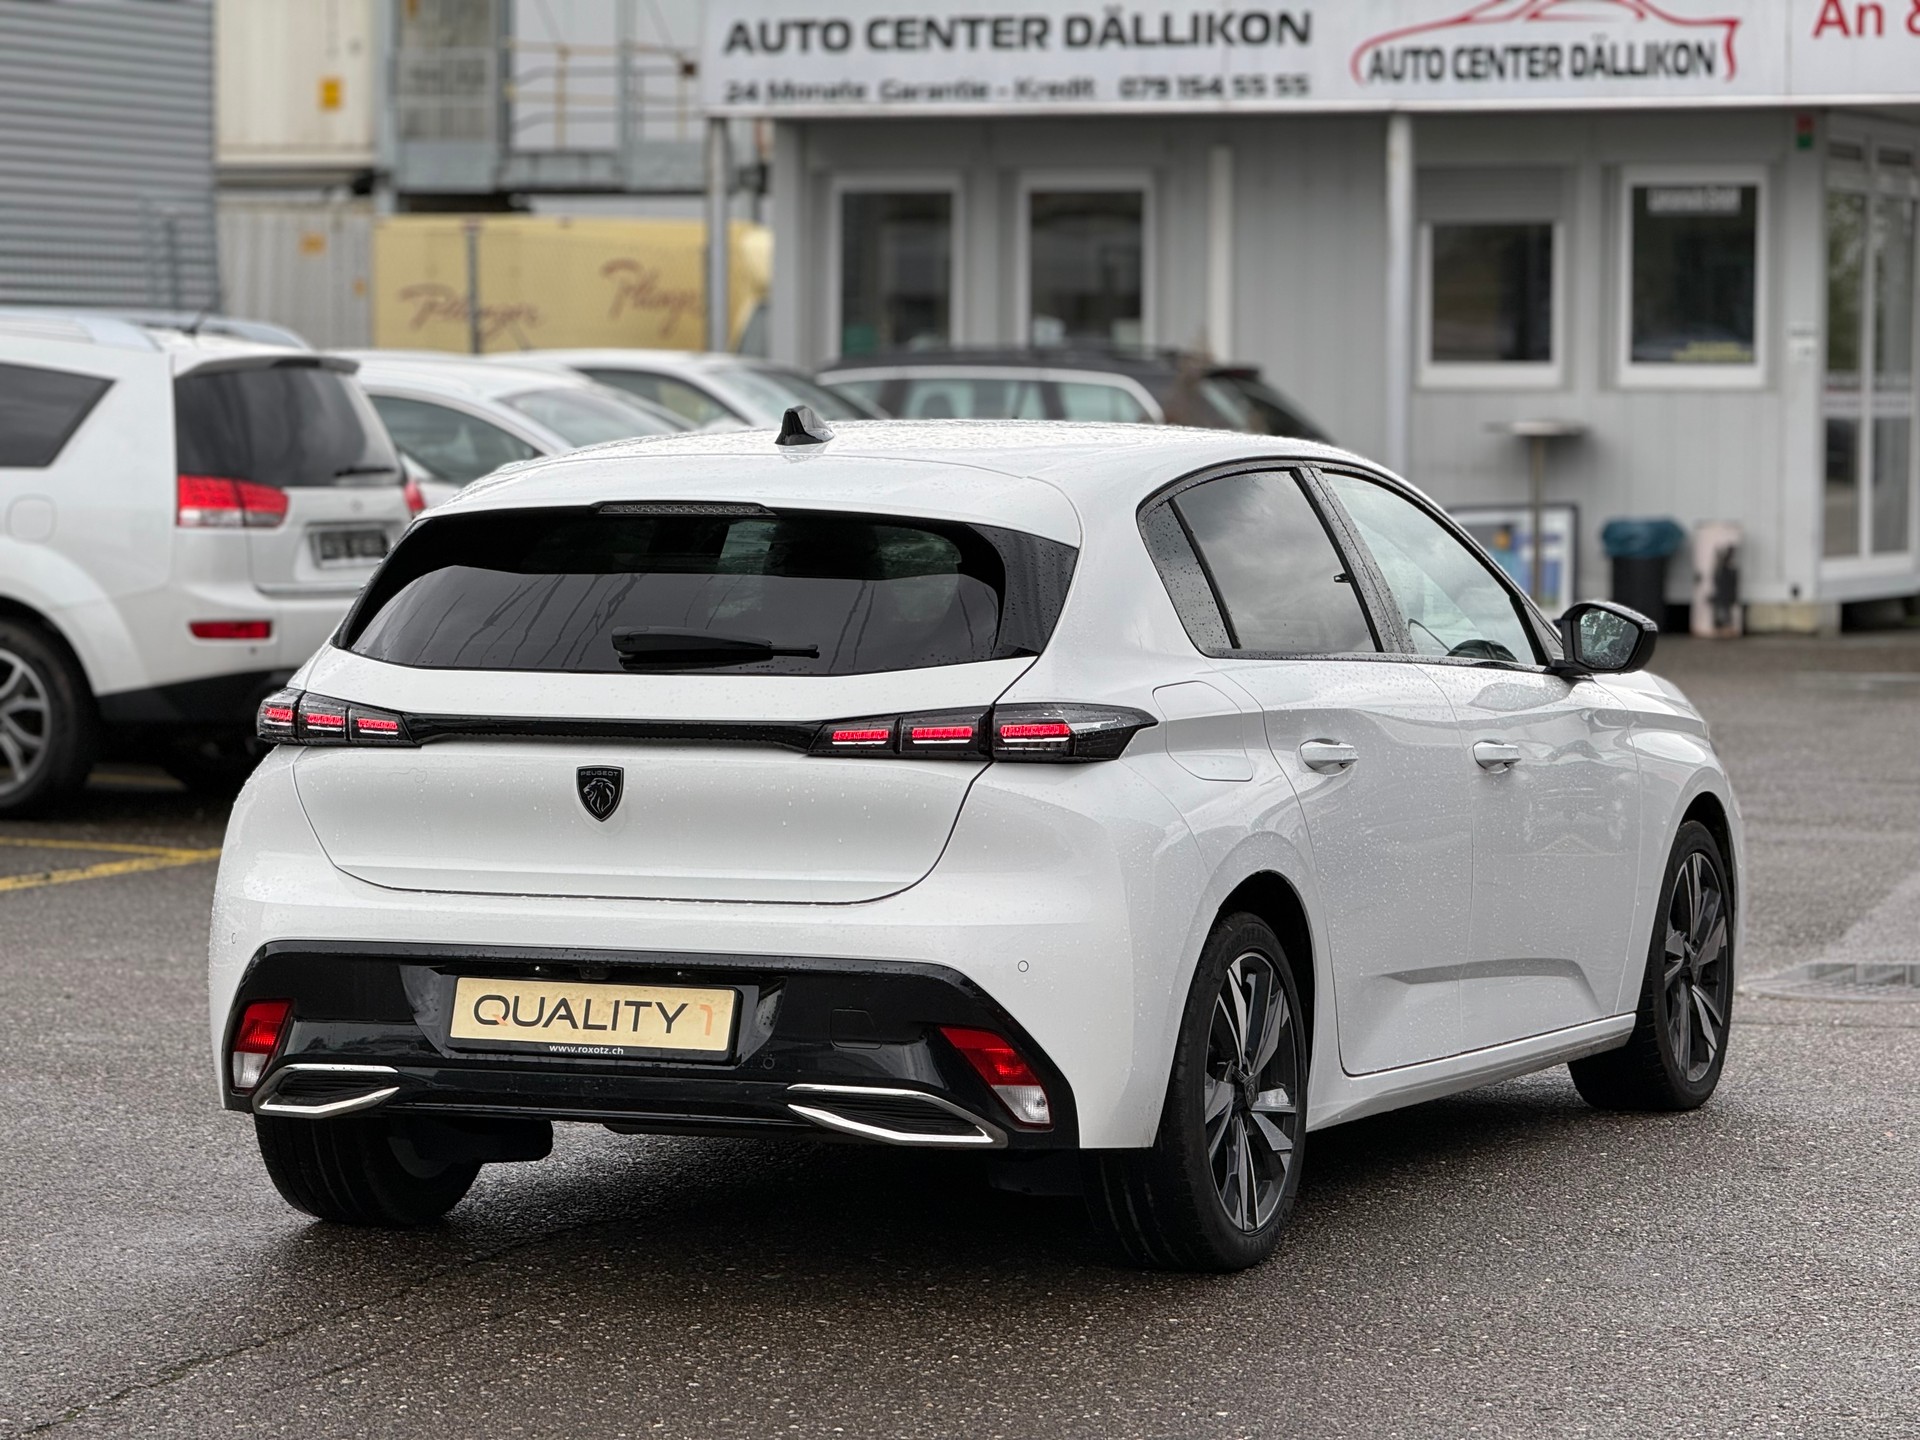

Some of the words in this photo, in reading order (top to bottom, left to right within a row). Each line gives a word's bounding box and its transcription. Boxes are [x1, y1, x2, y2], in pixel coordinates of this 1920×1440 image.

[725, 18, 853, 54] AUTO
[865, 15, 1051, 52] CENTER
[1064, 3, 1312, 50] DÄLLIKON
[1812, 0, 1884, 38] An
[1368, 46, 1446, 82] AUTO
[1453, 45, 1563, 81] CENTER
[1570, 33, 1716, 77] DÄLLIKON
[725, 80, 760, 102] 24
[1118, 75, 1171, 99] 079
[1177, 74, 1224, 98] 154
[1232, 73, 1268, 97] 55
[1273, 73, 1311, 96] 55
[473, 994, 689, 1034] QUALITY
[549, 1045, 624, 1055] www.roxotz.ch
